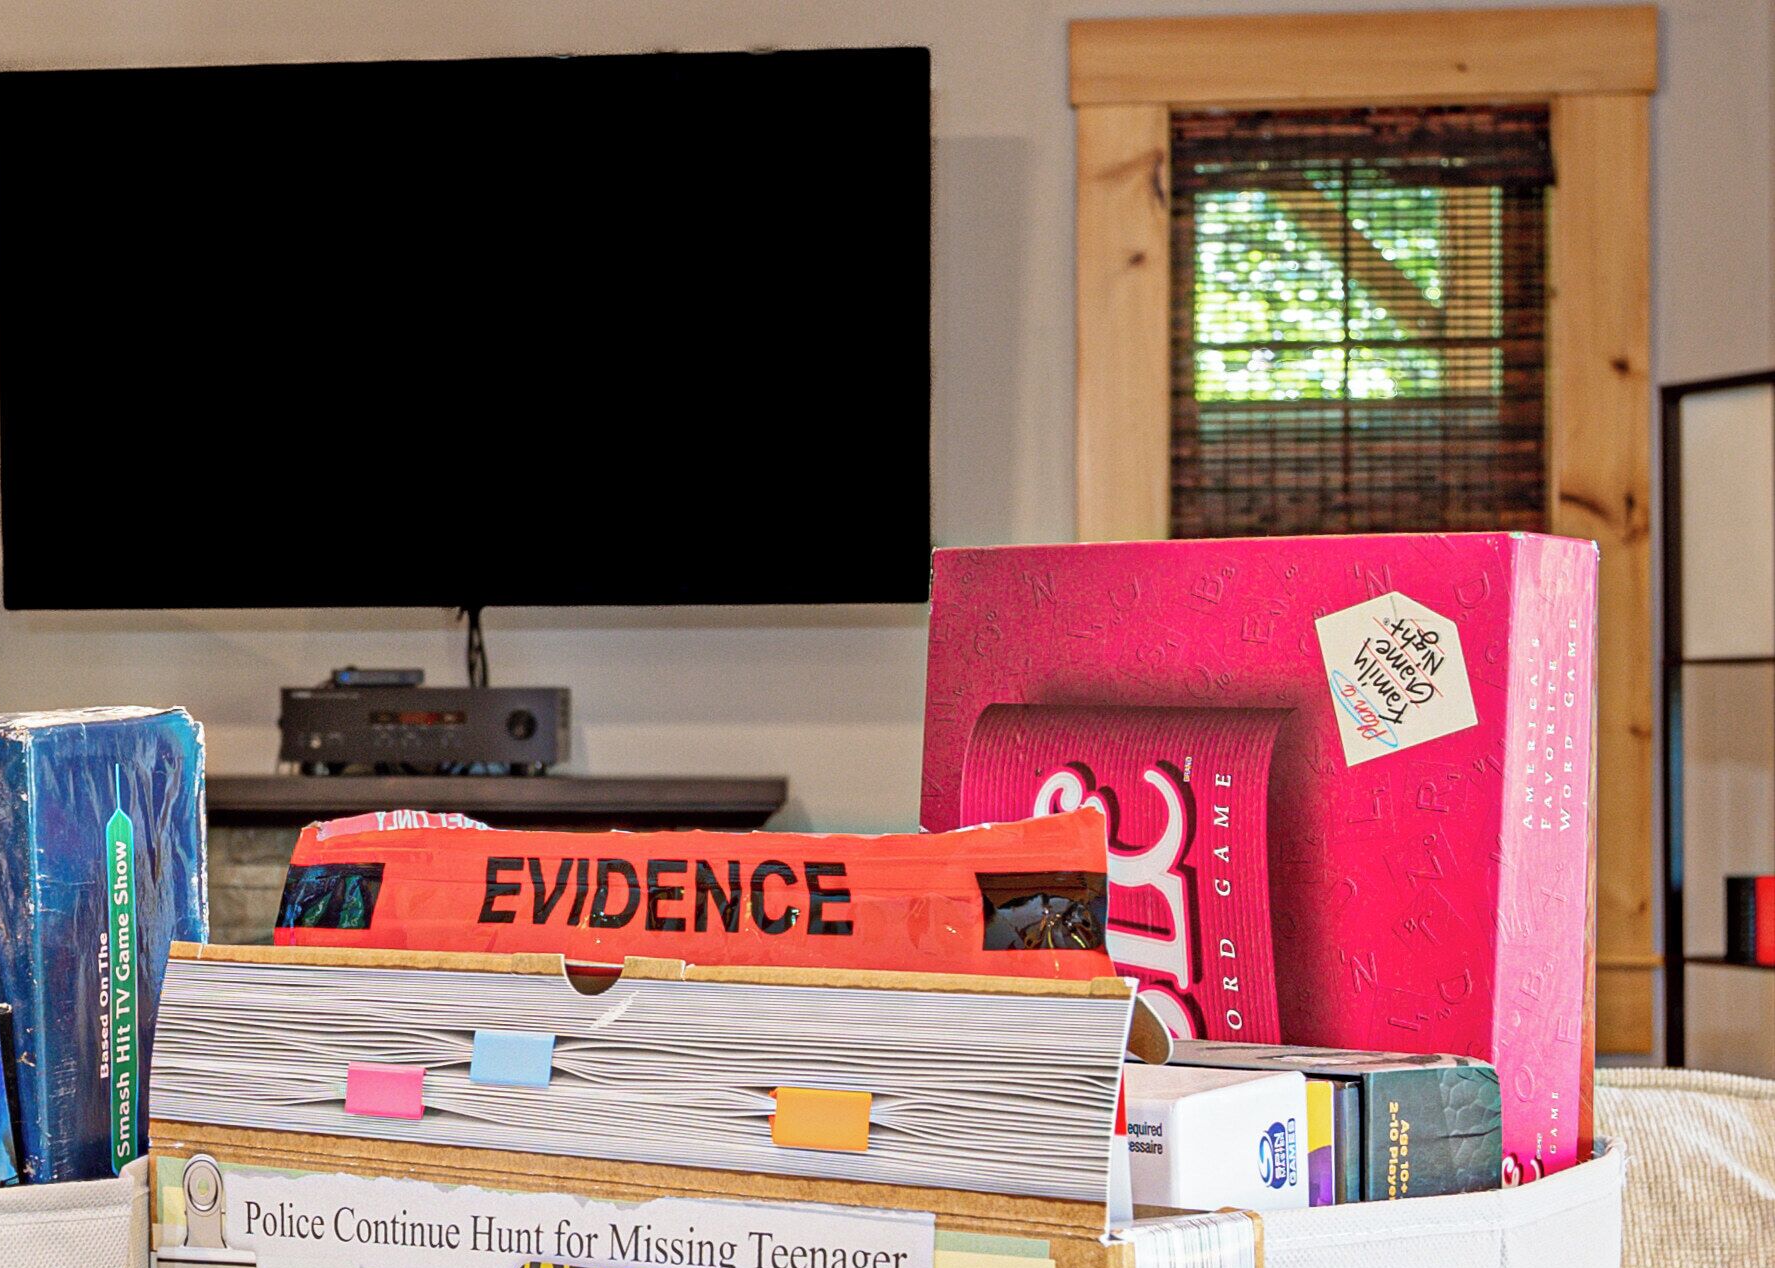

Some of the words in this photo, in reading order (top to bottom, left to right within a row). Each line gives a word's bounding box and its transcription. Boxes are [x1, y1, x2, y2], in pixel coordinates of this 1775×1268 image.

[1375, 640, 1434, 703] Game
[1391, 619, 1444, 676] Night
[1563, 618, 1577, 707] GAME
[1354, 638, 1408, 724] Family
[1523, 638, 1540, 829] AMERICA'S
[1541, 661, 1558, 829] FAVORITE
[1560, 736, 1573, 832] WORD
[1213, 774, 1232, 896] GAME
[114, 841, 128, 905] Show
[477, 856, 853, 936] EVIDENCE
[98, 932, 109, 973] The
[115, 913, 131, 981] Game
[99, 977, 109, 1007] On
[116, 988, 131, 1019] TV
[1219, 939, 1243, 1030] ORD
[99, 1013, 109, 1079] Based
[116, 1024, 131, 1063] Hit
[116, 1072, 131, 1157] Smash
[1127, 1121, 1163, 1138] equired
[1389, 1101, 1399, 1142] 2-10
[1399, 1119, 1410, 1157] Age
[1128, 1139, 1164, 1155] essaire
[1400, 1161, 1410, 1194] 10+
[245, 1201, 325, 1240] Police
[334, 1206, 461, 1250] Continue
[470, 1215, 544, 1255] Hunt
[554, 1219, 599, 1258] for
